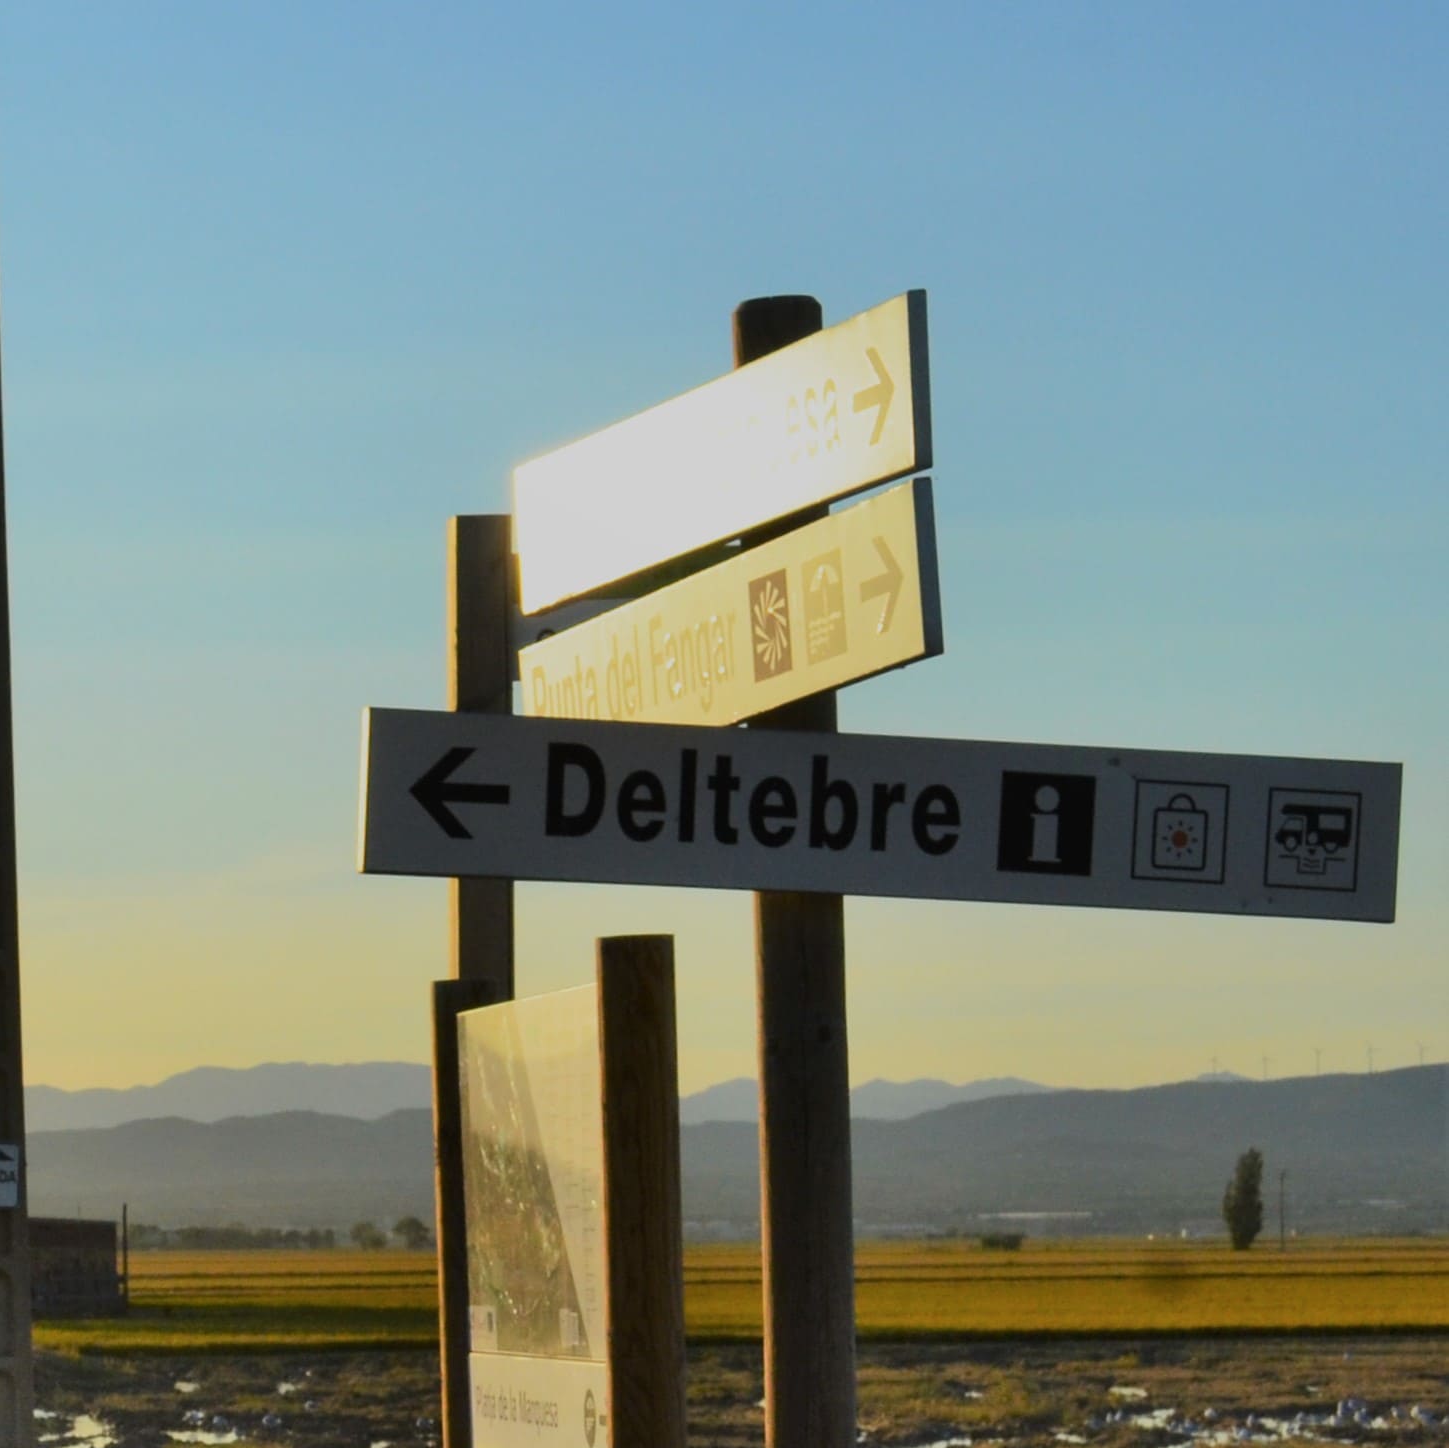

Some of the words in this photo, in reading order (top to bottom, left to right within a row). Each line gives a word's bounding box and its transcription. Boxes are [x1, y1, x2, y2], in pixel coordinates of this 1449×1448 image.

[531, 654, 599, 719] Punta
[606, 622, 643, 719] del
[648, 611, 737, 713] Fangar
[544, 741, 962, 857] Deltebre
